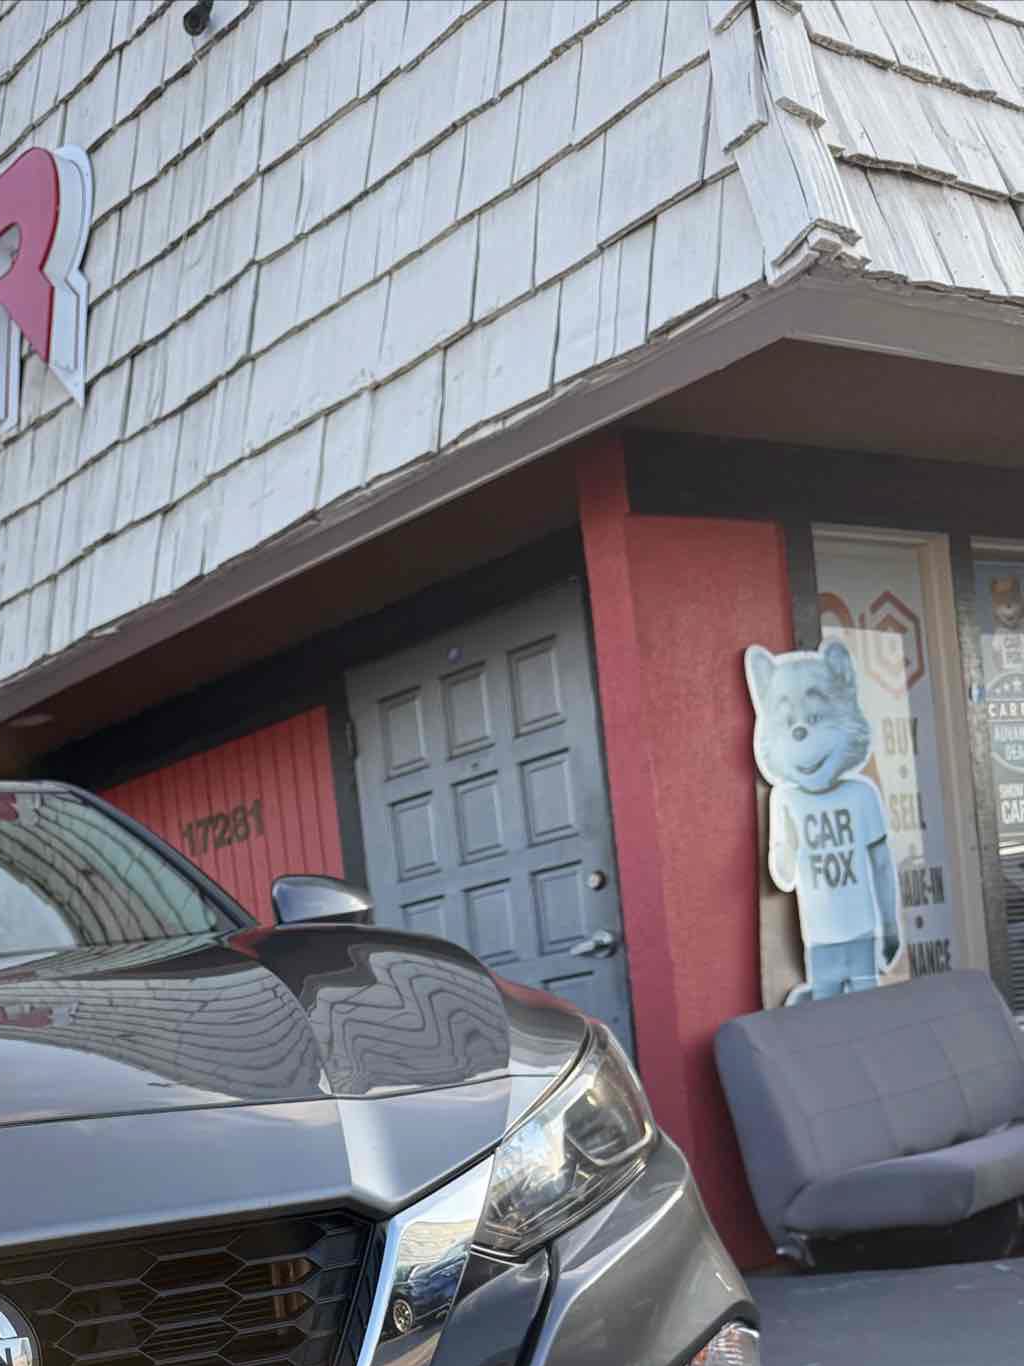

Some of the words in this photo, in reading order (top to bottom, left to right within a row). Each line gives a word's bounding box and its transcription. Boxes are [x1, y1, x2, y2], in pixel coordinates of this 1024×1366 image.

[883, 717, 919, 756] BUY
[182, 799, 265, 857] 17281
[804, 808, 854, 850] CAR
[808, 850, 858, 889] FOX
[908, 937, 952, 977] NANCE
